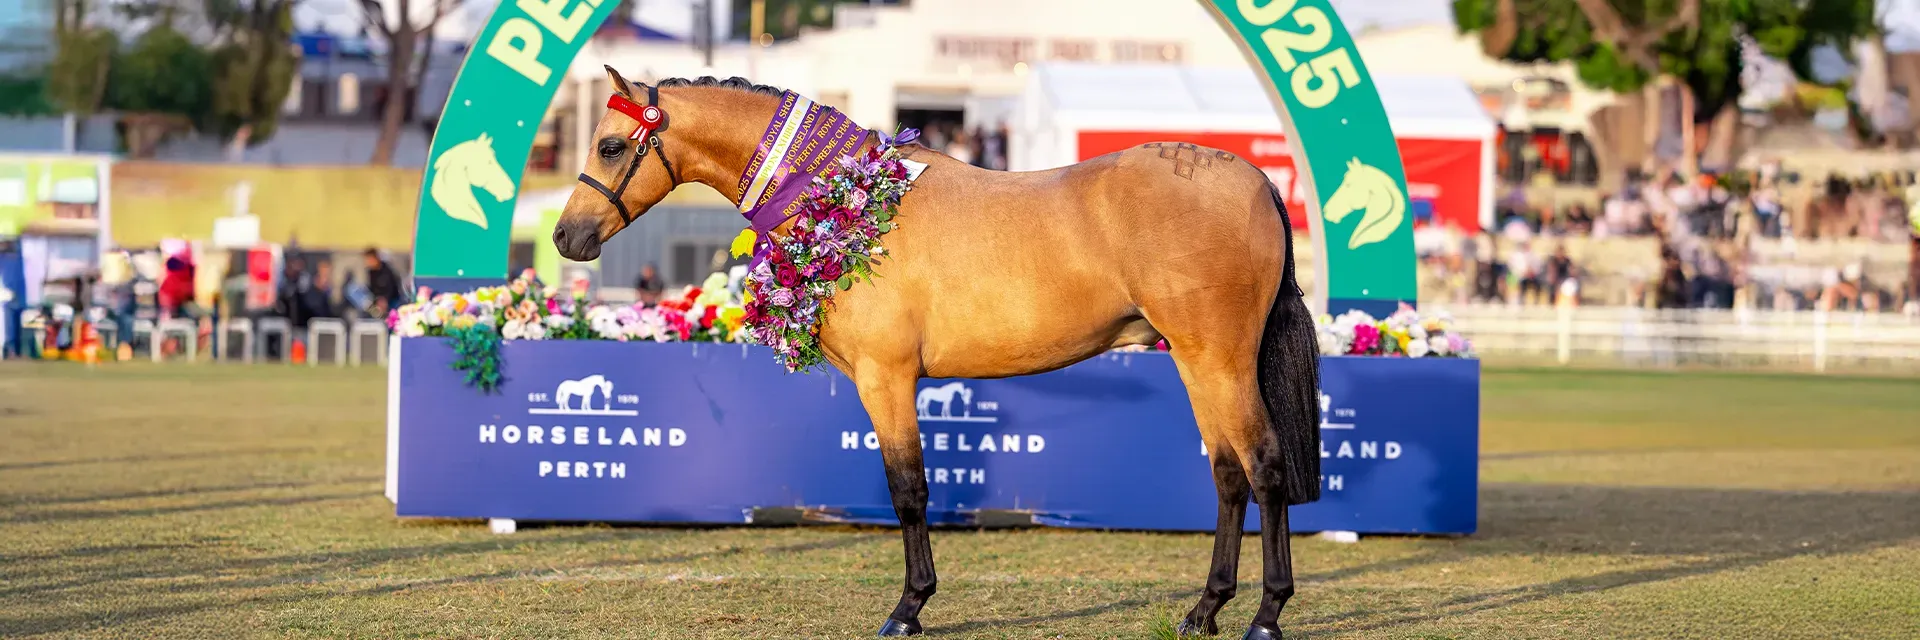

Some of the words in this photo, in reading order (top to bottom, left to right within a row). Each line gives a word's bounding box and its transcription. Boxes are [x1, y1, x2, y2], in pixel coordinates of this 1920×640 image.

[486, 0, 604, 87] PE
[737, 178, 750, 200] 2025
[746, 148, 767, 179] PERTH
[763, 120, 784, 149] ROYAL
[779, 93, 796, 119] SHOW
[784, 113, 815, 164] HORSELAND
[794, 138, 819, 166] PERTH
[817, 115, 838, 139] ROYAL
[806, 137, 839, 174] SUPREME
[478, 424, 688, 447] HORSELAND
[841, 430, 1046, 453] HOELAND
[538, 460, 627, 479] PERTH
